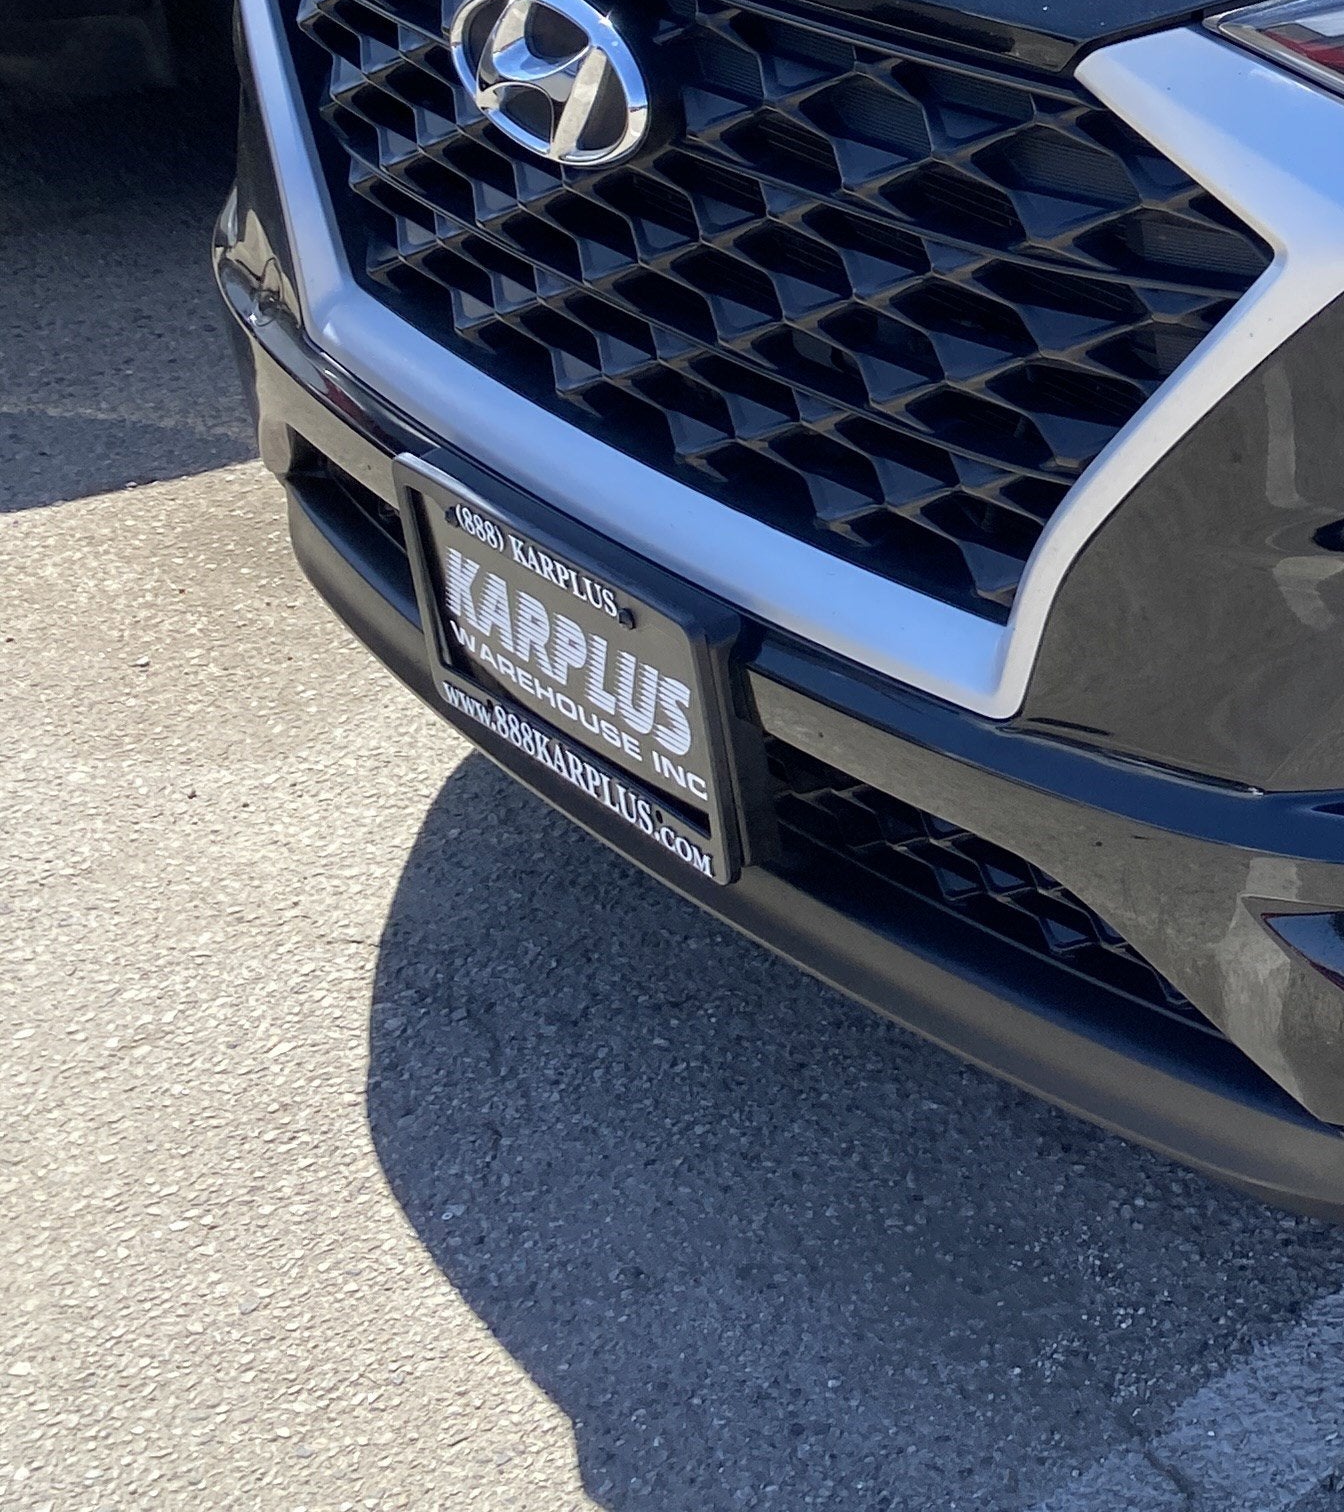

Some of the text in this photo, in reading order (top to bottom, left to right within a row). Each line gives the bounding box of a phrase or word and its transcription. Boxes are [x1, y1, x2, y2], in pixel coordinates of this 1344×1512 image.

[444, 546, 692, 756] KARPLUS
[455, 503, 619, 619] (888) KARPLUS
[449, 620, 709, 802] WAREHOUSE INC
